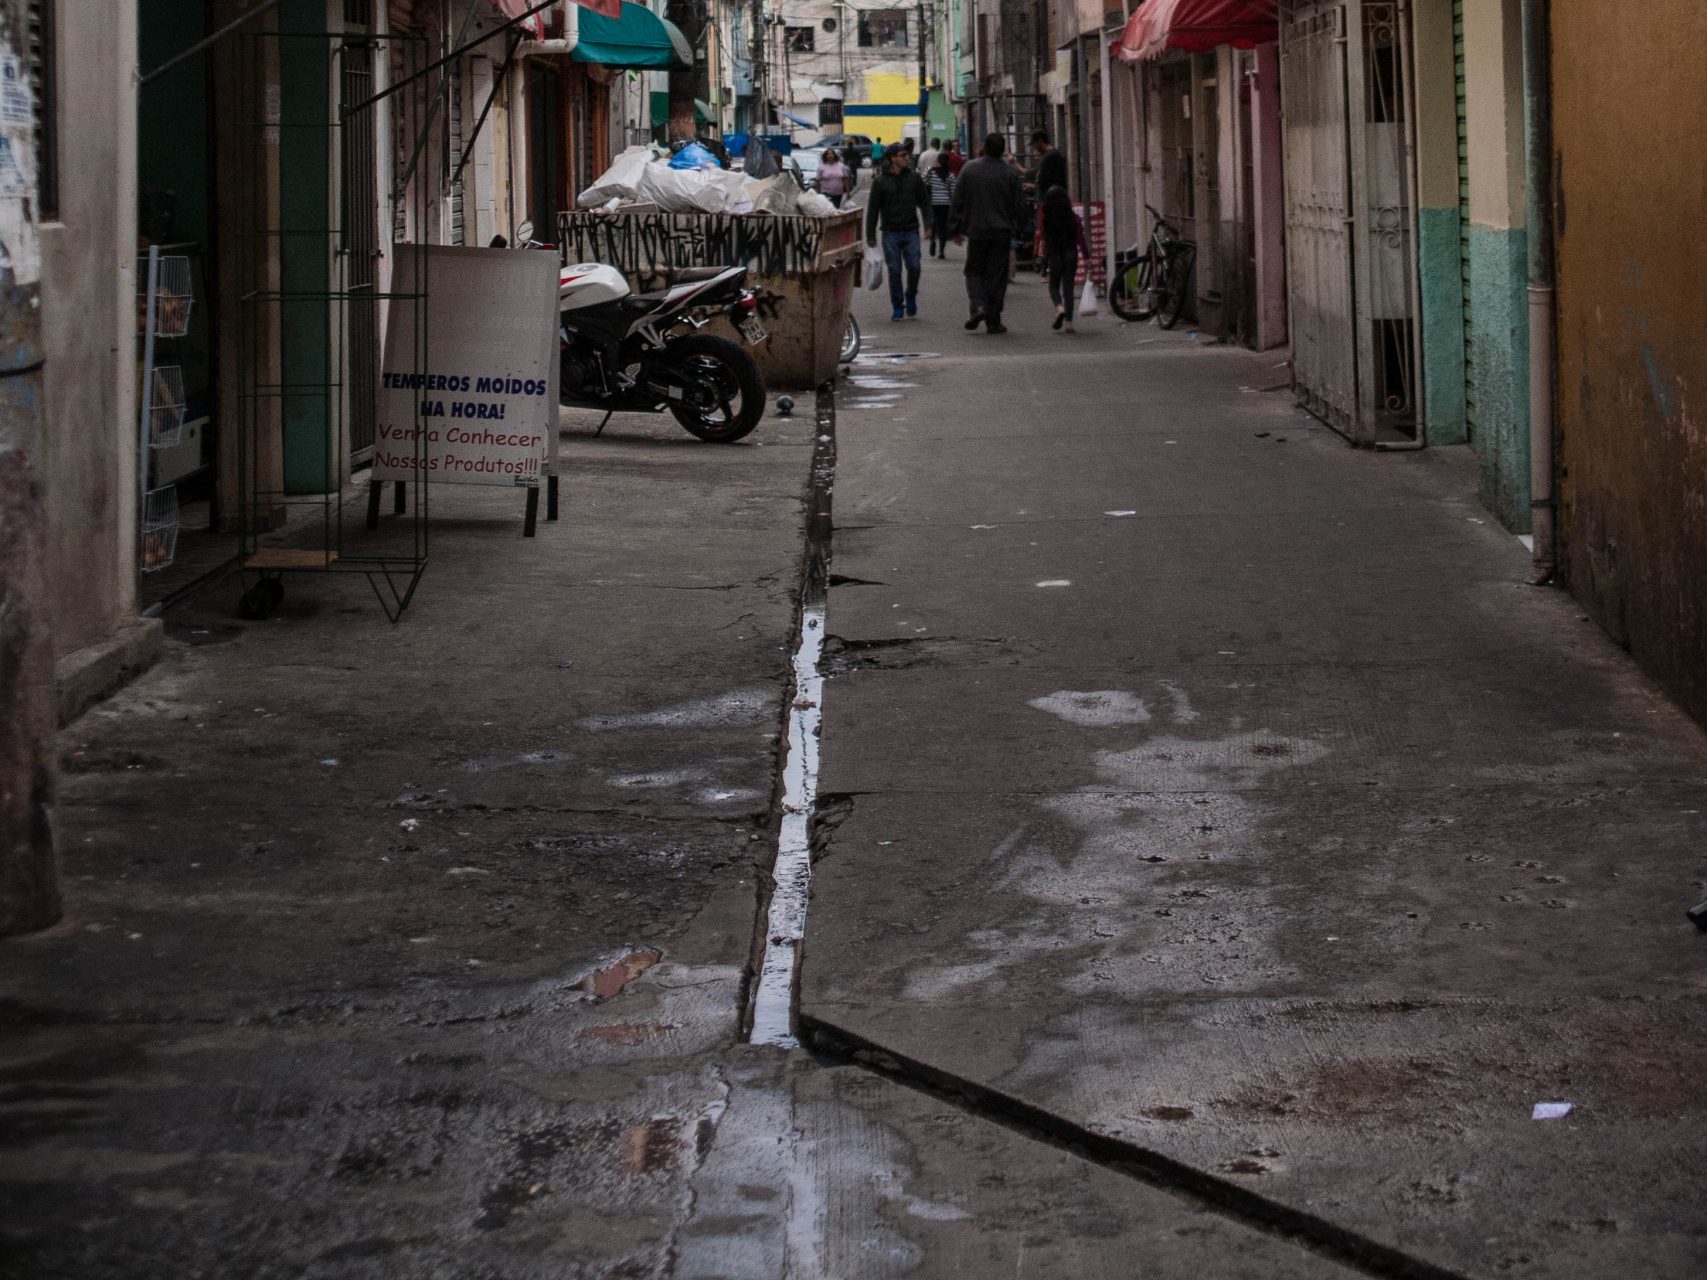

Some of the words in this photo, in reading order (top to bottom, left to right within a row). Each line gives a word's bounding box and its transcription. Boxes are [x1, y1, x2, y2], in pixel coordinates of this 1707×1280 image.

[383, 373, 470, 392] TEMPEROS
[475, 373, 546, 395] MOÍDOS
[420, 401, 445, 417] NA
[450, 402, 506, 420] HORA!
[378, 423, 439, 442] Venha
[446, 427, 541, 448] Conhecer
[374, 451, 439, 470] Nossas
[444, 454, 538, 475] Produtos!!!
